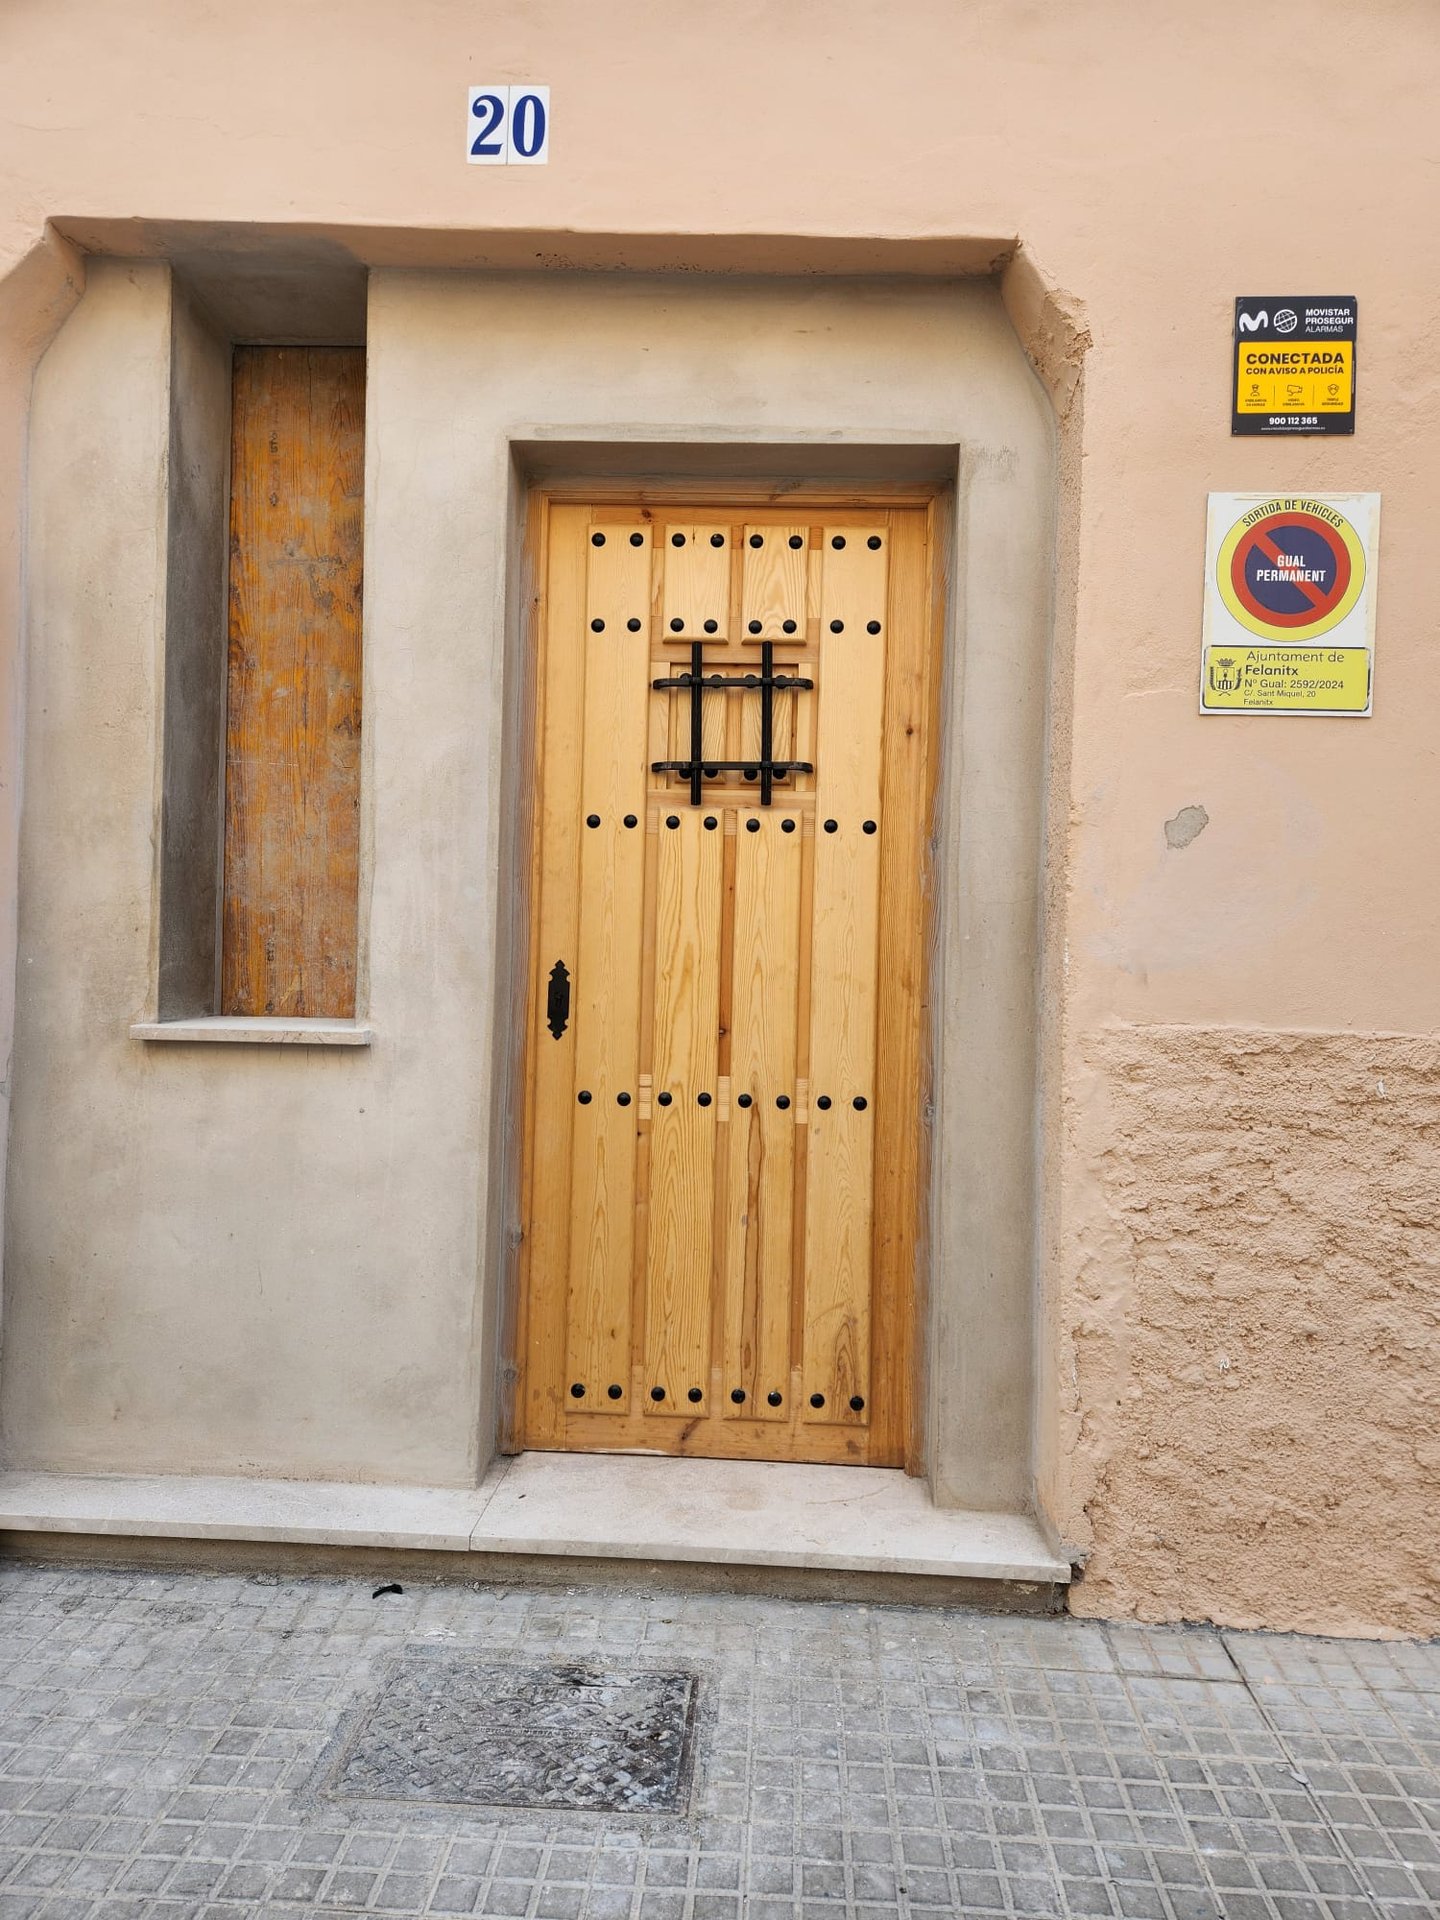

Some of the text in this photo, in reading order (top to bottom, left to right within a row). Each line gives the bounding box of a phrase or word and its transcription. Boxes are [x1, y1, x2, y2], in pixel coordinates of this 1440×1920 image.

[471, 94, 546, 158] 20
[1305, 309, 1350, 317] MOVISTAR
[1305, 317, 1354, 325] PROSEGUR
[1305, 325, 1344, 333] ALARMAS
[1246, 353, 1345, 365] CONECTADA
[1245, 367, 1267, 375] CON
[1269, 367, 1297, 375] AVISO
[1307, 365, 1344, 374] POLICÍA
[1269, 416, 1318, 425] 900 112 365
[1242, 500, 1344, 528] SORTIDA DE VEHICLES
[1277, 555, 1306, 568] GUAL
[1256, 569, 1327, 582] PERMANENT
[1246, 651, 1345, 664] Ajuntament de
[1245, 665, 1299, 676] Felanitx
[1260, 679, 1287, 689] Gual:
[1290, 680, 1344, 690] 2592/2024
[1243, 698, 1273, 706] Felanitx
